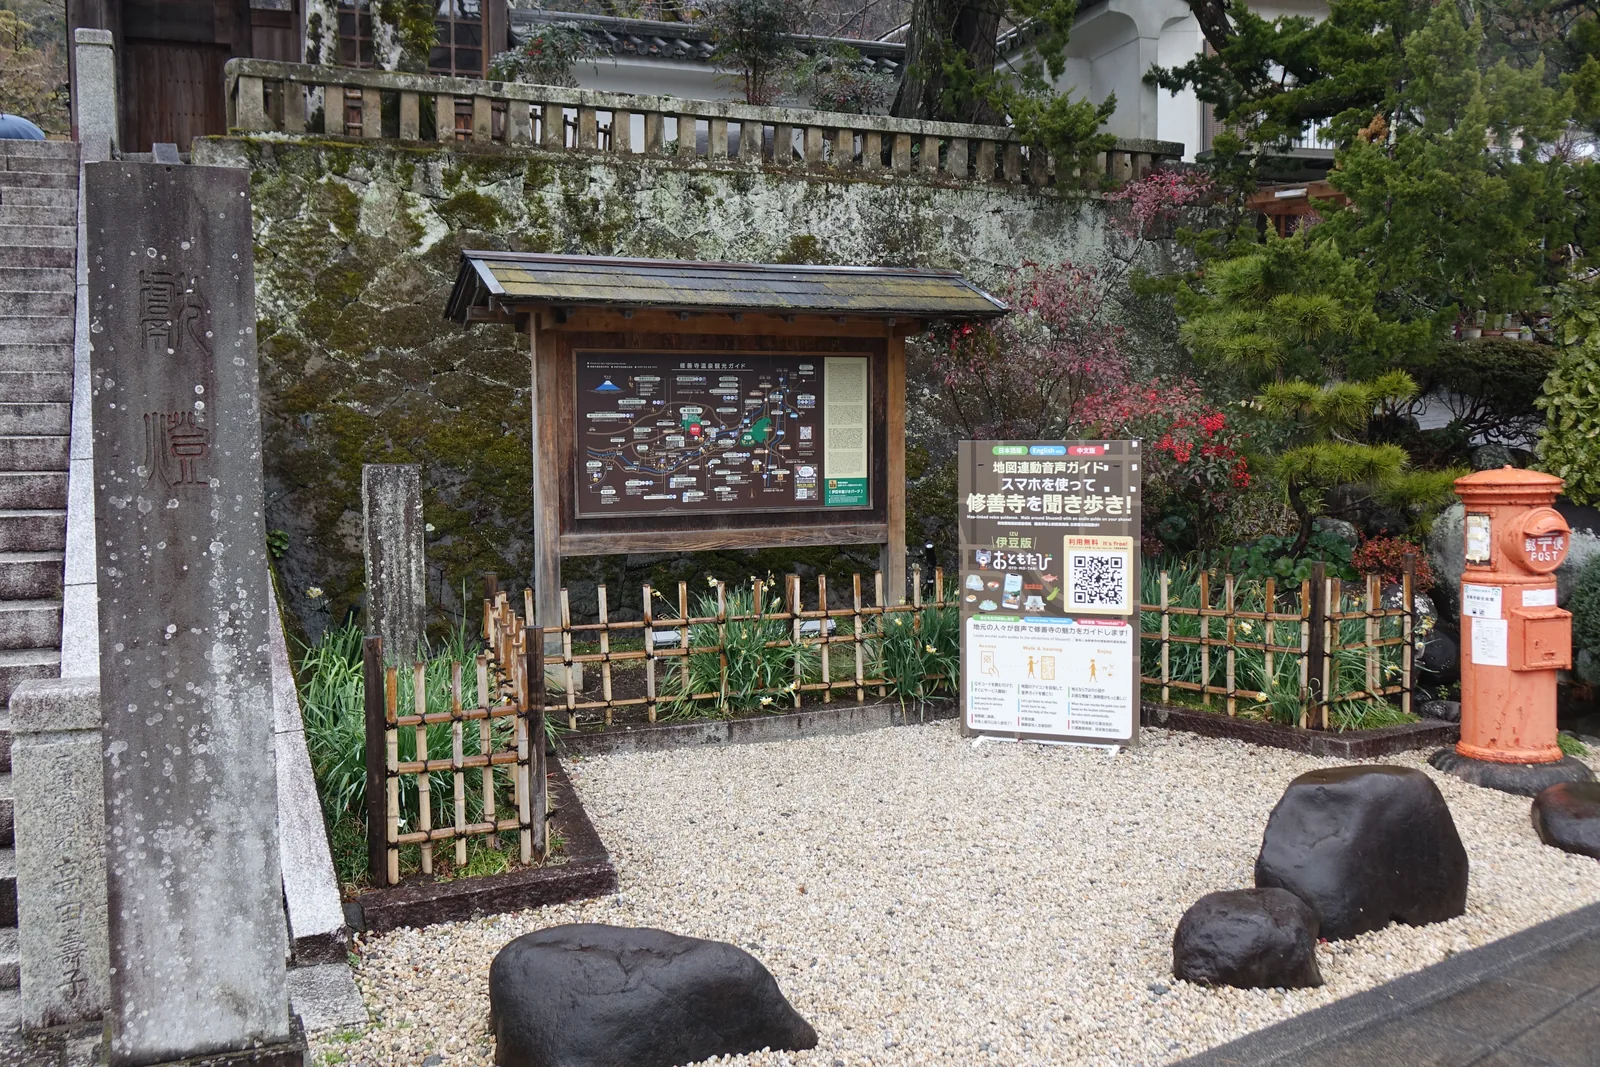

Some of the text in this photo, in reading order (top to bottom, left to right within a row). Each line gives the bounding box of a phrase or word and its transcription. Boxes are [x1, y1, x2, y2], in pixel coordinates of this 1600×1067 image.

[1032, 447, 1055, 455] English
[993, 461, 1104, 474] 地図連動音声ガイド
[1001, 477, 1096, 492] スマホを使って
[996, 537, 1032, 549] 伊豆版
[1069, 538, 1098, 546] 利用無料
[993, 550, 1052, 570] おともたび
[1531, 551, 1558, 562] POST
[973, 623, 1128, 636] 地元の人々が音声で修善寺の魅力をガイドします!
